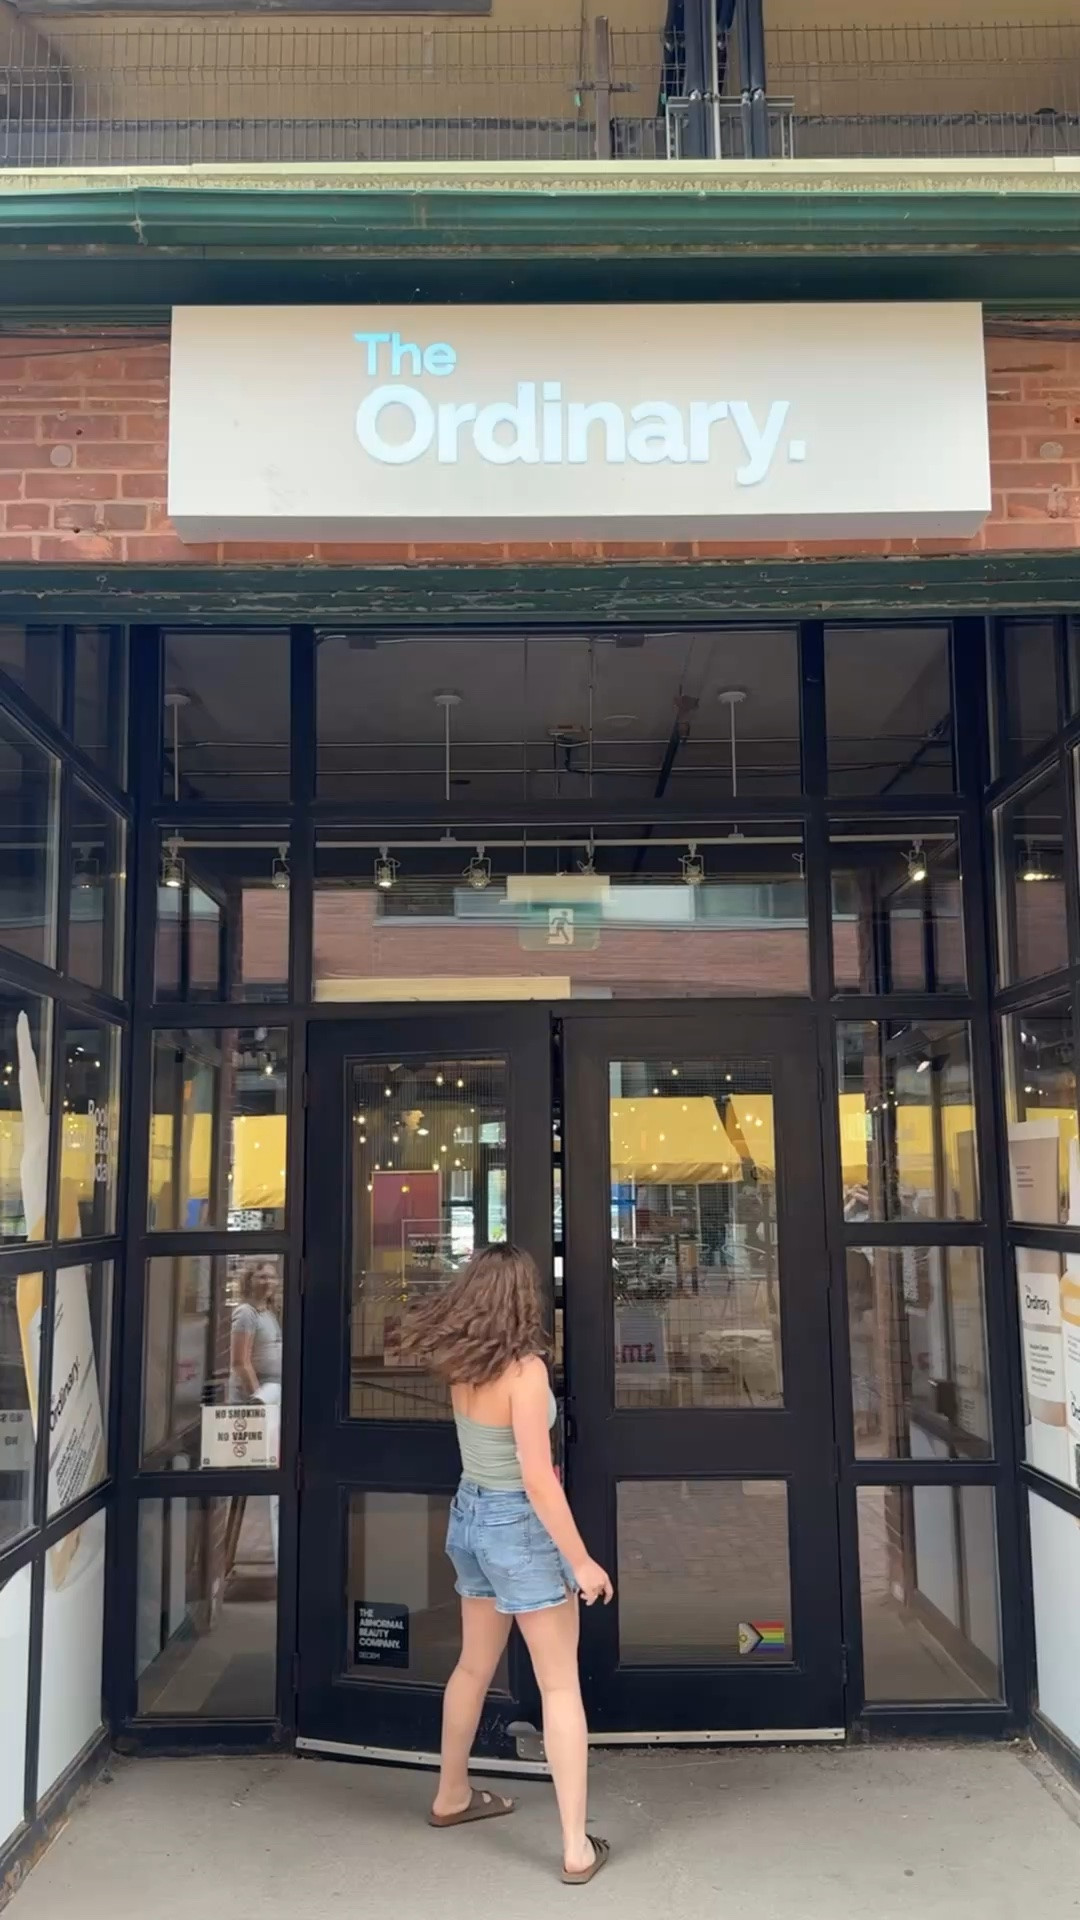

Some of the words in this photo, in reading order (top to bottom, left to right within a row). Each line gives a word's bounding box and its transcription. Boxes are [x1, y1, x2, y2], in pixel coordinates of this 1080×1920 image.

[354, 332, 457, 376] The
[355, 381, 807, 486] Ordinary.
[215, 1409, 227, 1419] NO
[228, 1408, 266, 1418] SMOKING
[217, 1431, 230, 1441] NO
[231, 1431, 263, 1441] VAPING
[359, 1608, 375, 1618] THE
[360, 1618, 405, 1630] ABNORMAL
[359, 1627, 390, 1639] BEAUTY
